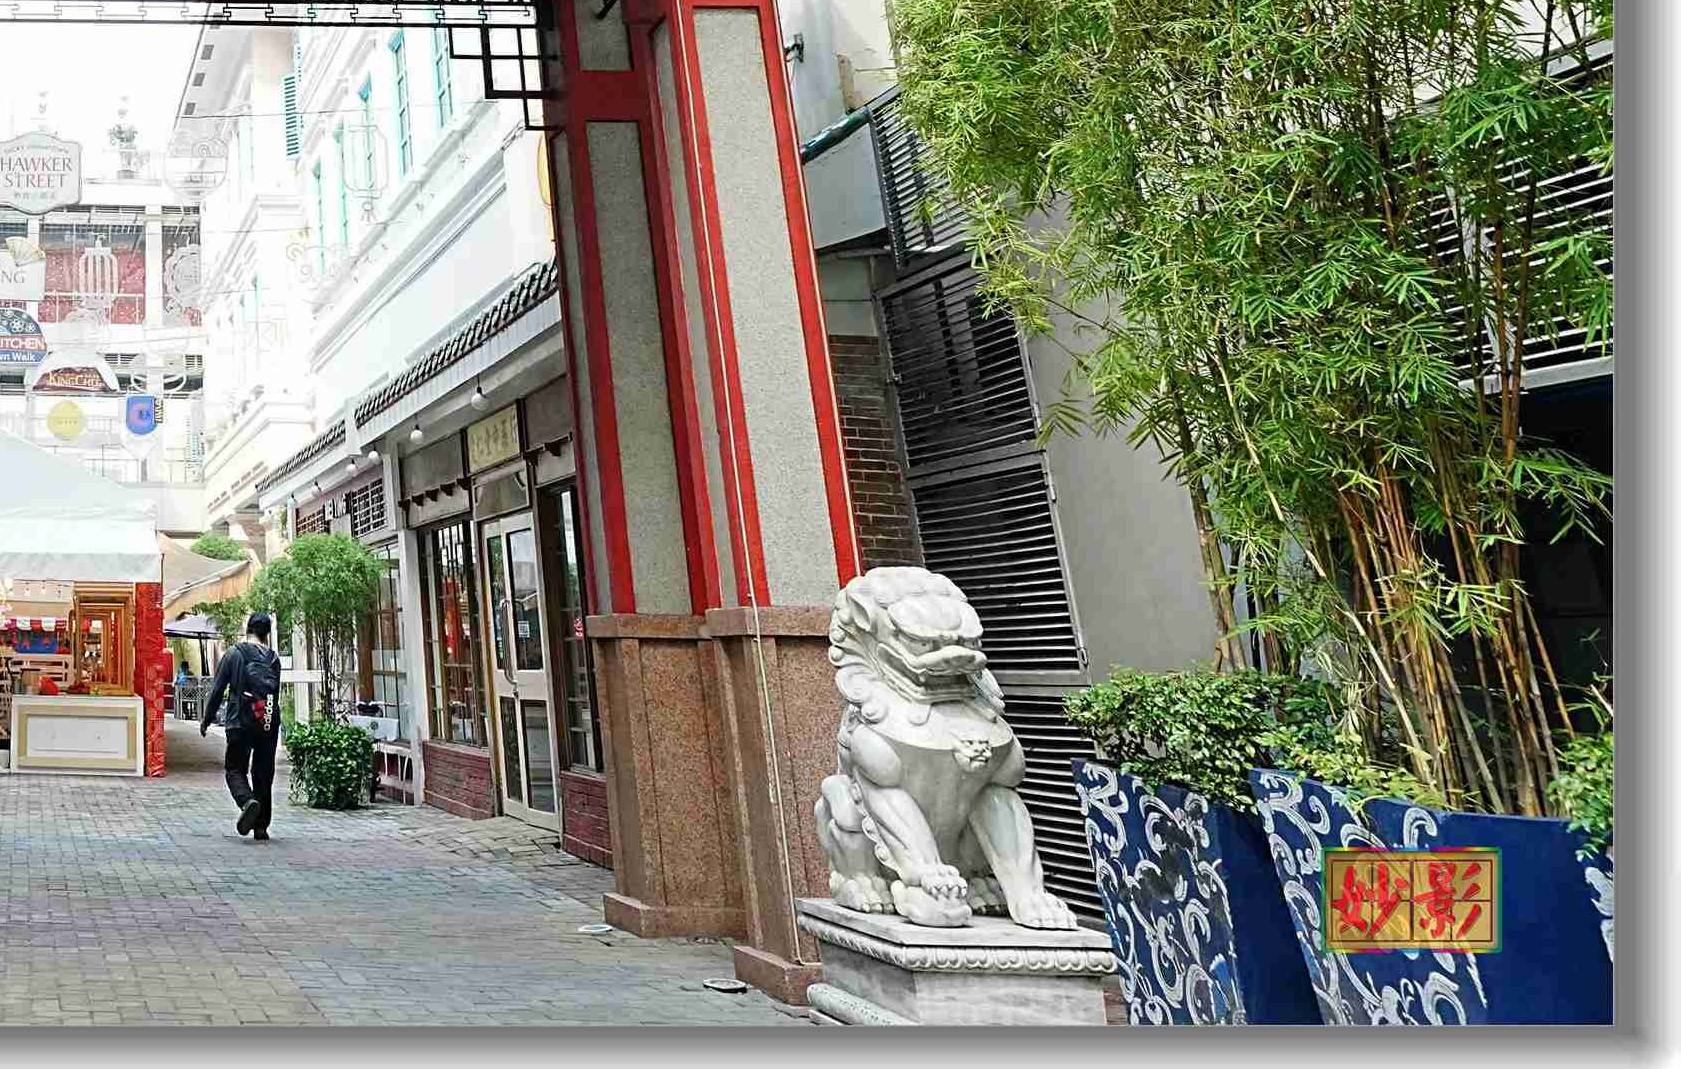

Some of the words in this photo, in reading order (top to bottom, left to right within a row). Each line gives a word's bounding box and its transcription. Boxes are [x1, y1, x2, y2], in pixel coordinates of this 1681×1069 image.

[0, 156, 73, 172] HAWKER
[4, 172, 67, 188] STREET
[13, 351, 36, 362] Walk
[263, 693, 274, 731] adidas
